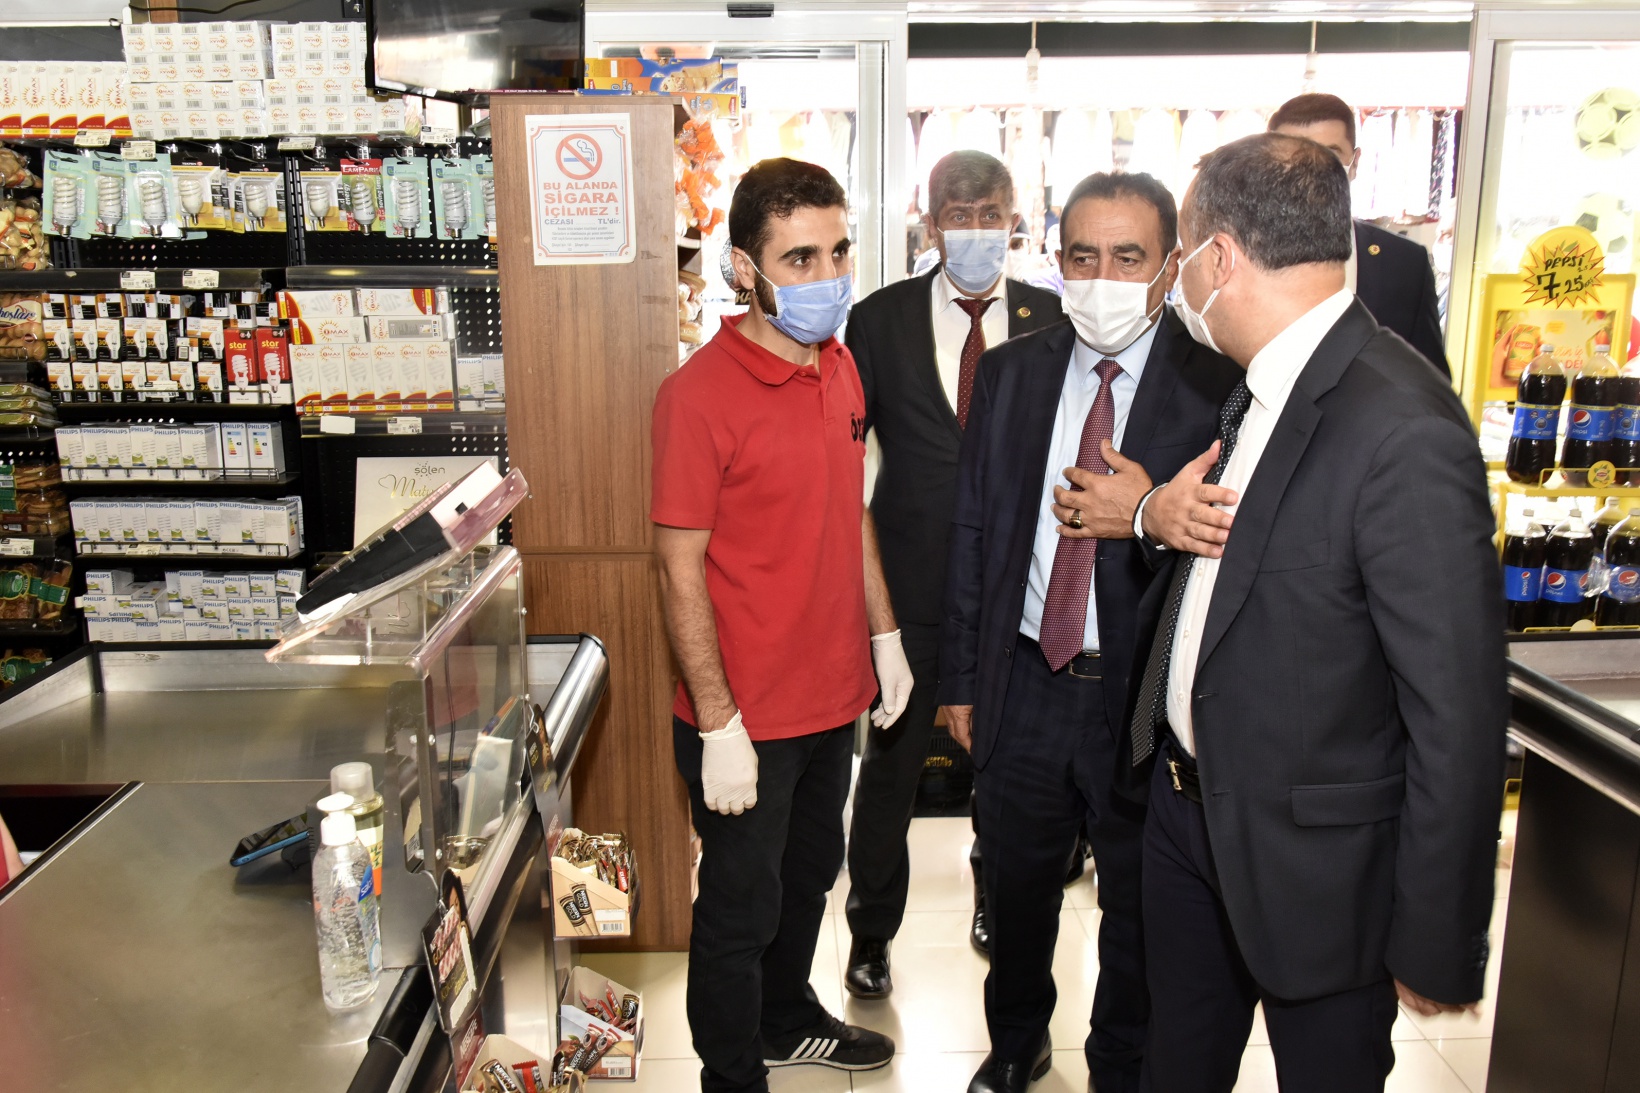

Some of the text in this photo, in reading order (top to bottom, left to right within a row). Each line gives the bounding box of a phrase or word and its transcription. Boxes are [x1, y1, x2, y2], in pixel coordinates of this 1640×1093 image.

[566, 182, 618, 190] ALANDA
[544, 190, 618, 204] SİGARA
[545, 206, 608, 218] İÇİLMEZ
